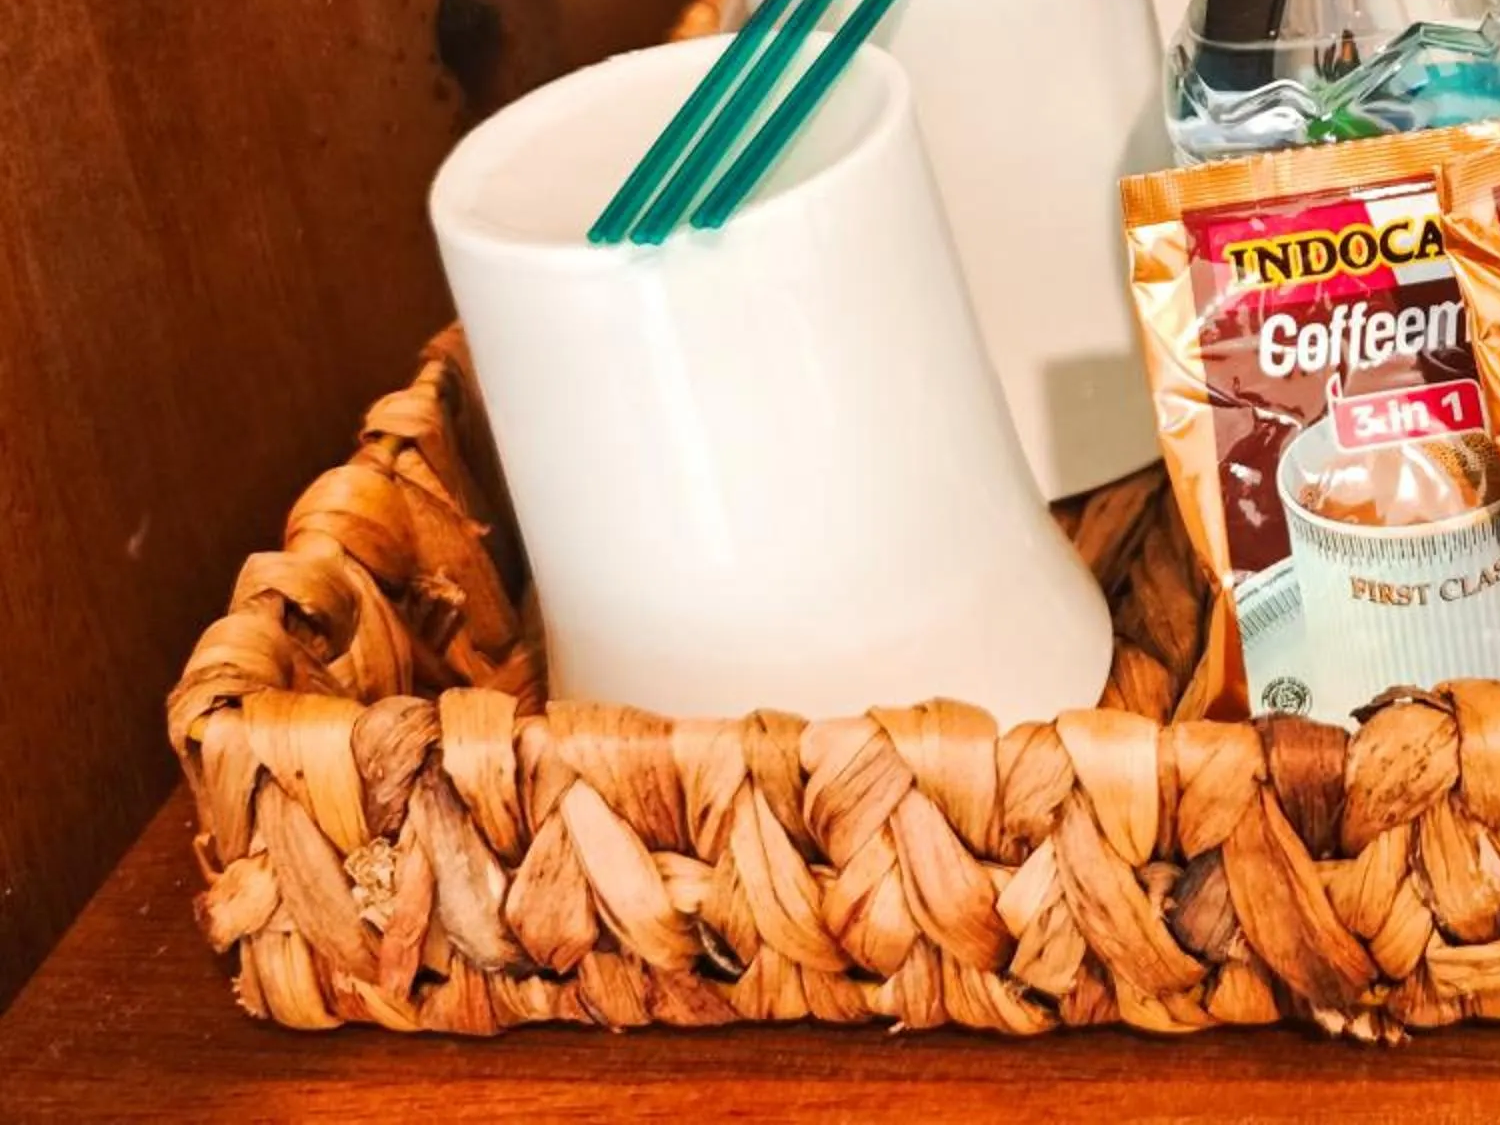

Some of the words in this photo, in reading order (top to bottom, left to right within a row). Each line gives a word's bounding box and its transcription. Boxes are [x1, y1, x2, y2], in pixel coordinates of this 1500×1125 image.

[1350, 404, 1378, 437] 3
[1440, 390, 1464, 422] 1
[1350, 576, 1430, 606] FIRST
